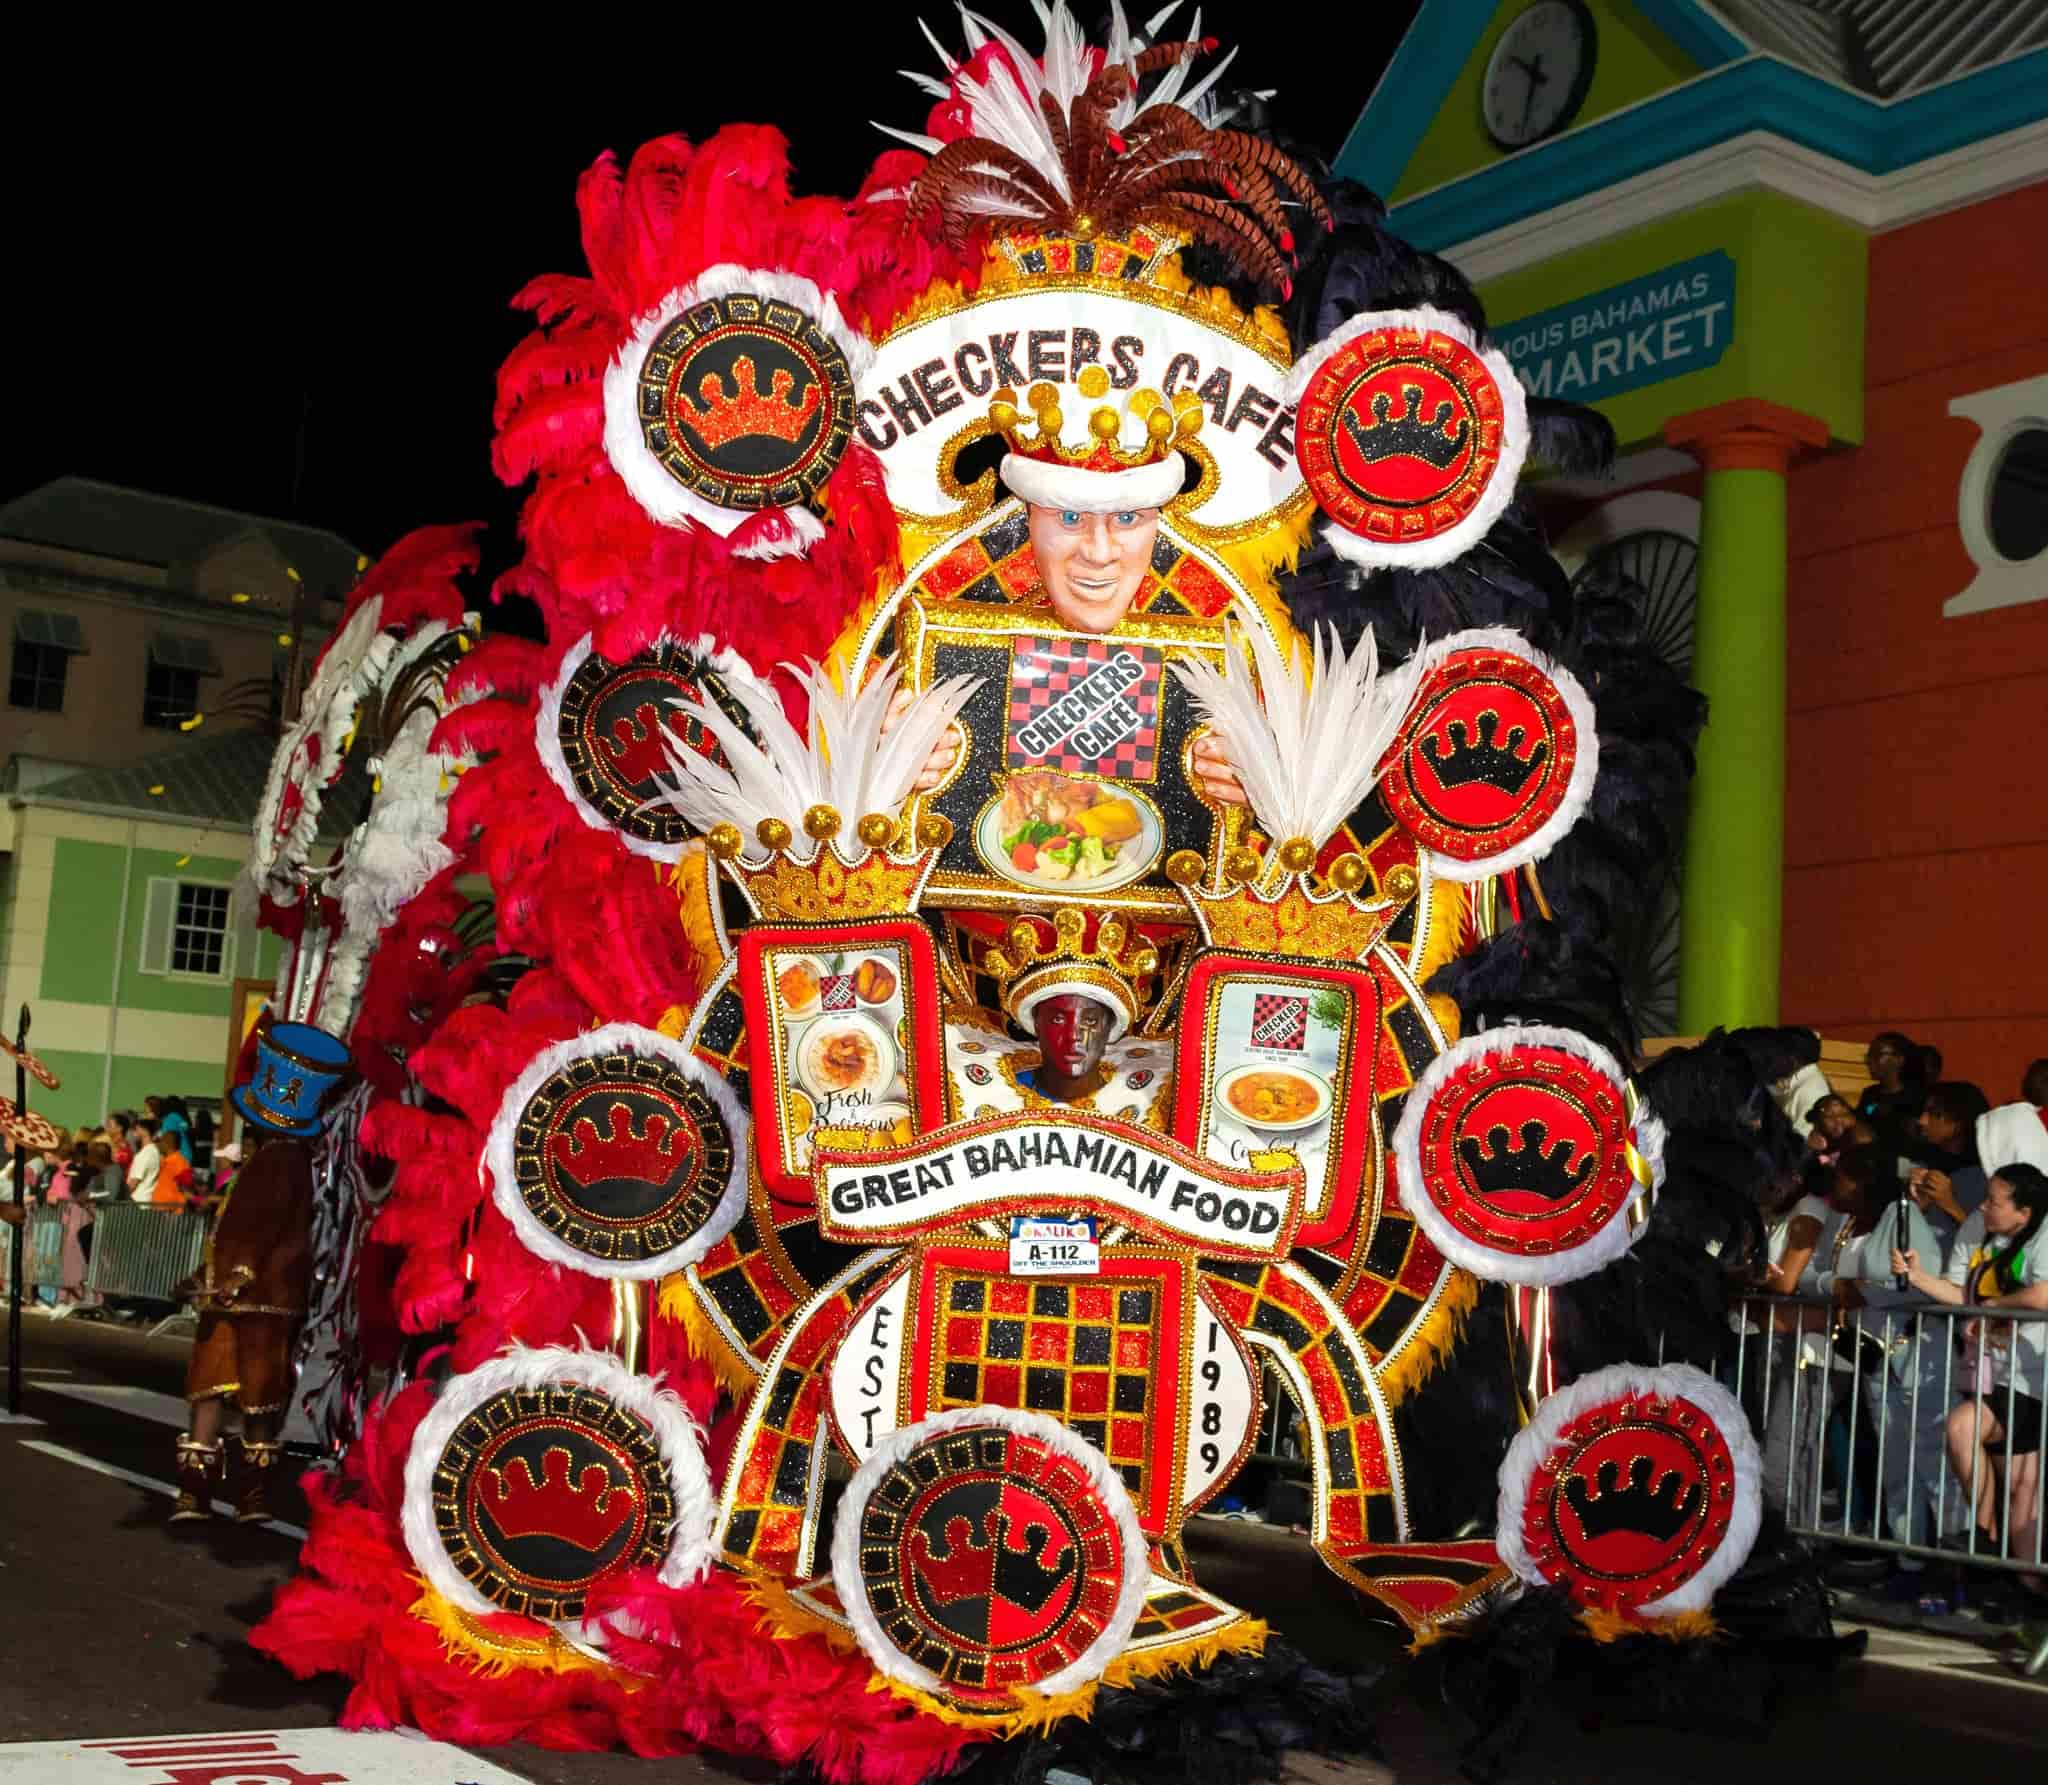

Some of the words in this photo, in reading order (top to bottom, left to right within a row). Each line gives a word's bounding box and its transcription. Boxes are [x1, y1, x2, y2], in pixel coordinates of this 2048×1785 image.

[1571, 273, 1709, 339] BAHAMAS
[856, 327, 1144, 451] CHECKERS
[1519, 301, 1727, 398] MARKET
[1018, 653, 1144, 757] CHECKERS
[1072, 699, 1141, 759] CAFÉ
[1255, 1000, 1301, 1041] CHECKERS
[816, 1086, 873, 1116] Fresh
[831, 1153, 956, 1216] GREAT
[962, 1131, 1170, 1200] BAHAMIAN
[1169, 1179, 1281, 1234] FOOD
[1029, 1244, 1080, 1260] A-112
[1033, 1225, 1075, 1237] KALIK
[859, 1305, 893, 1449] EST
[1200, 1322, 1221, 1475] 1989
